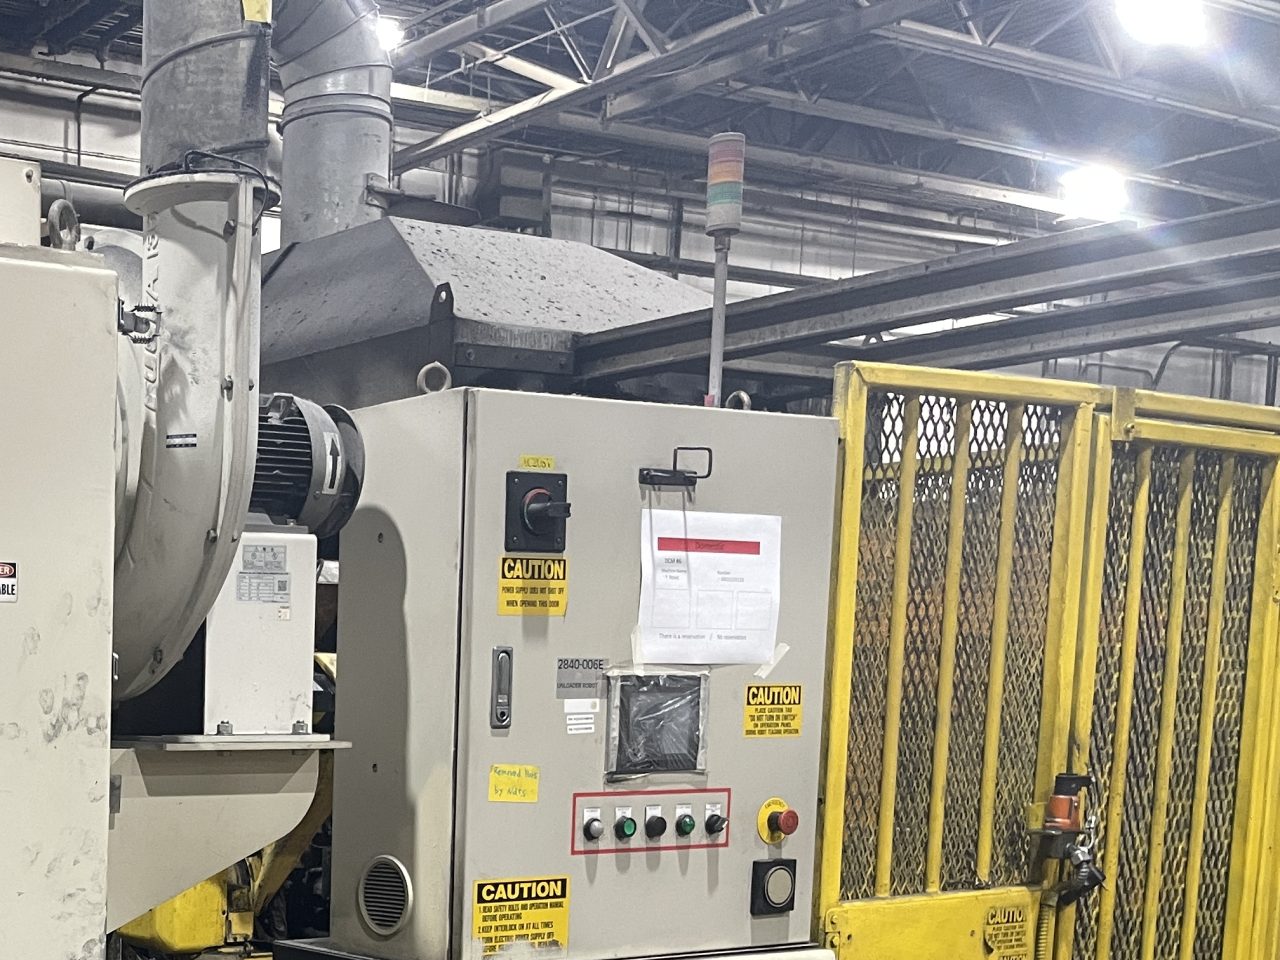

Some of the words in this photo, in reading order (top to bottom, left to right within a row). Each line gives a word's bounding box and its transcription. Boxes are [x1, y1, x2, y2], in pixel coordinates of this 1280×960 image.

[504, 559, 564, 579] CAUTION
[557, 659, 604, 670] 2840-006E
[749, 686, 800, 705] CAUTION
[482, 881, 561, 900] CAUTION
[989, 908, 1025, 924] CAUTIO
[494, 924, 517, 932] INTERLOCK
[531, 932, 545, 940] SUPPLY
